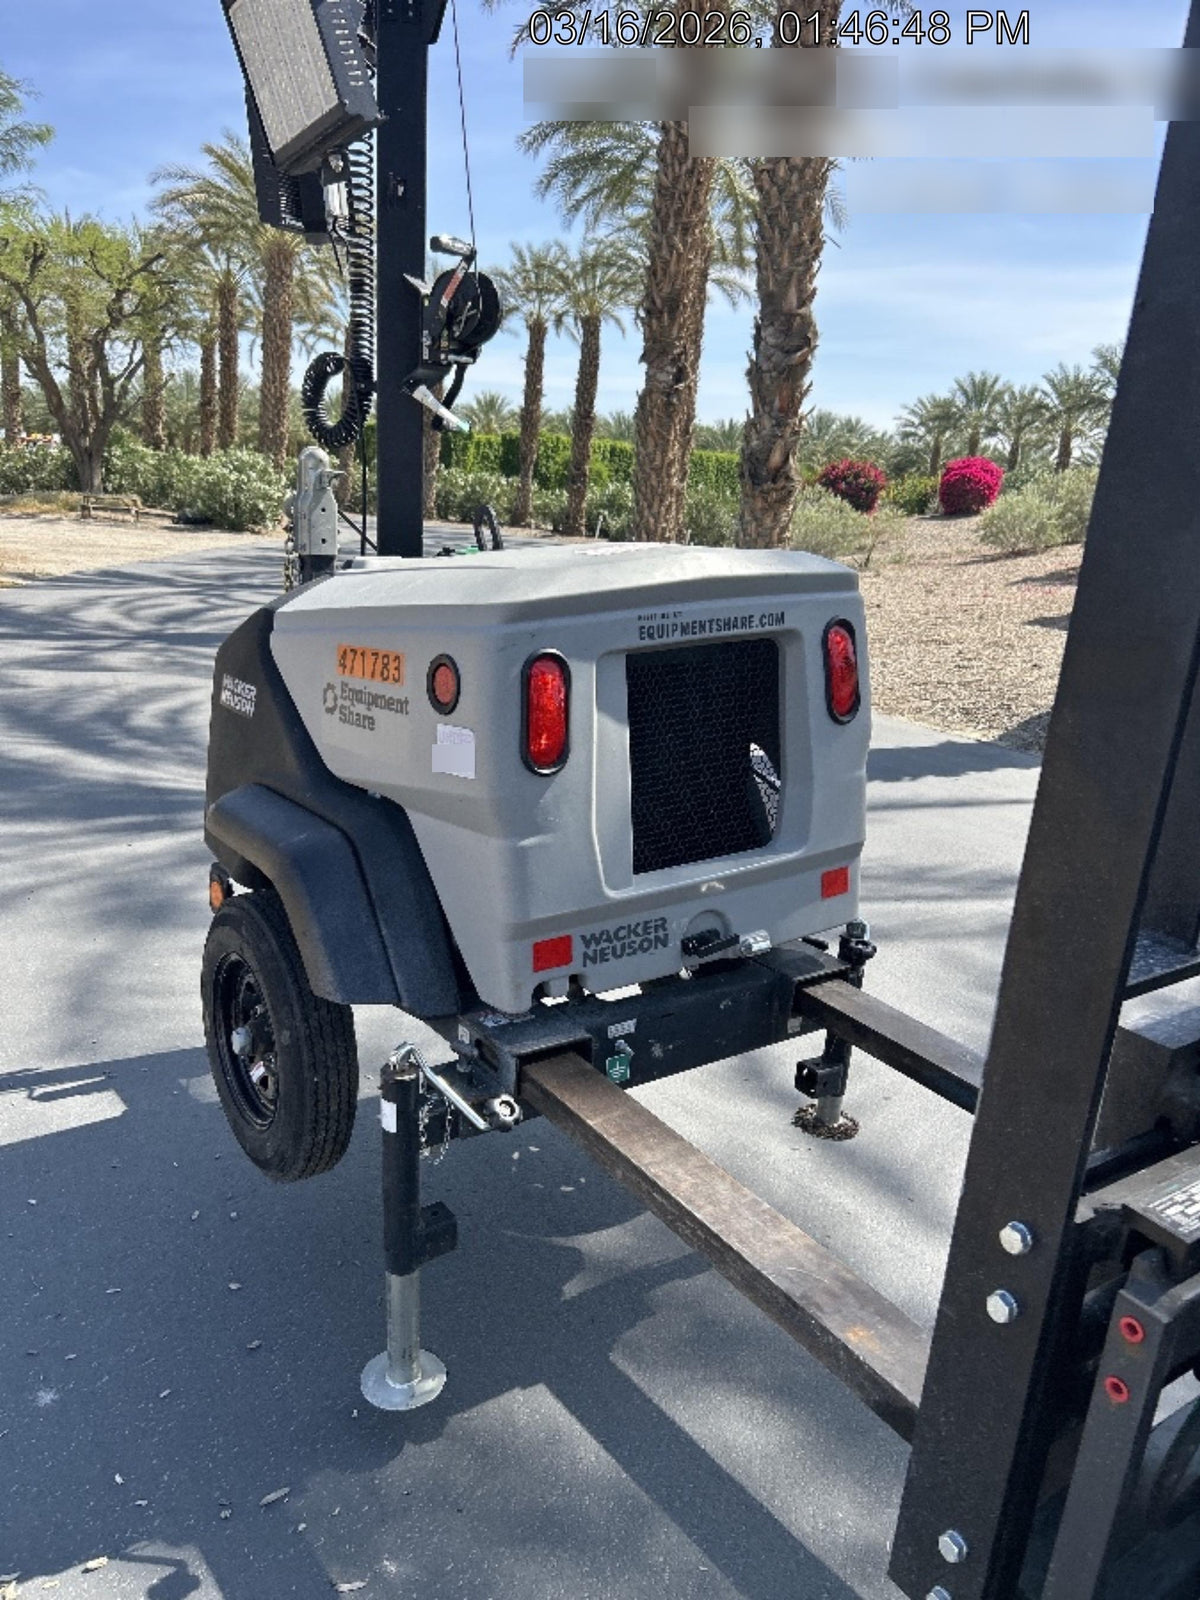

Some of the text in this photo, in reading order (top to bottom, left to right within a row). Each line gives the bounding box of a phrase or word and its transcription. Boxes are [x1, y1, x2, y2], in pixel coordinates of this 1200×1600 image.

[638, 611, 786, 641] EQUIPMENTSHARE.COM
[339, 648, 401, 683] 471783
[340, 681, 410, 715] Equipment
[339, 704, 376, 731] Share
[579, 917, 668, 949] WACKER
[581, 933, 670, 968] NEUSON
